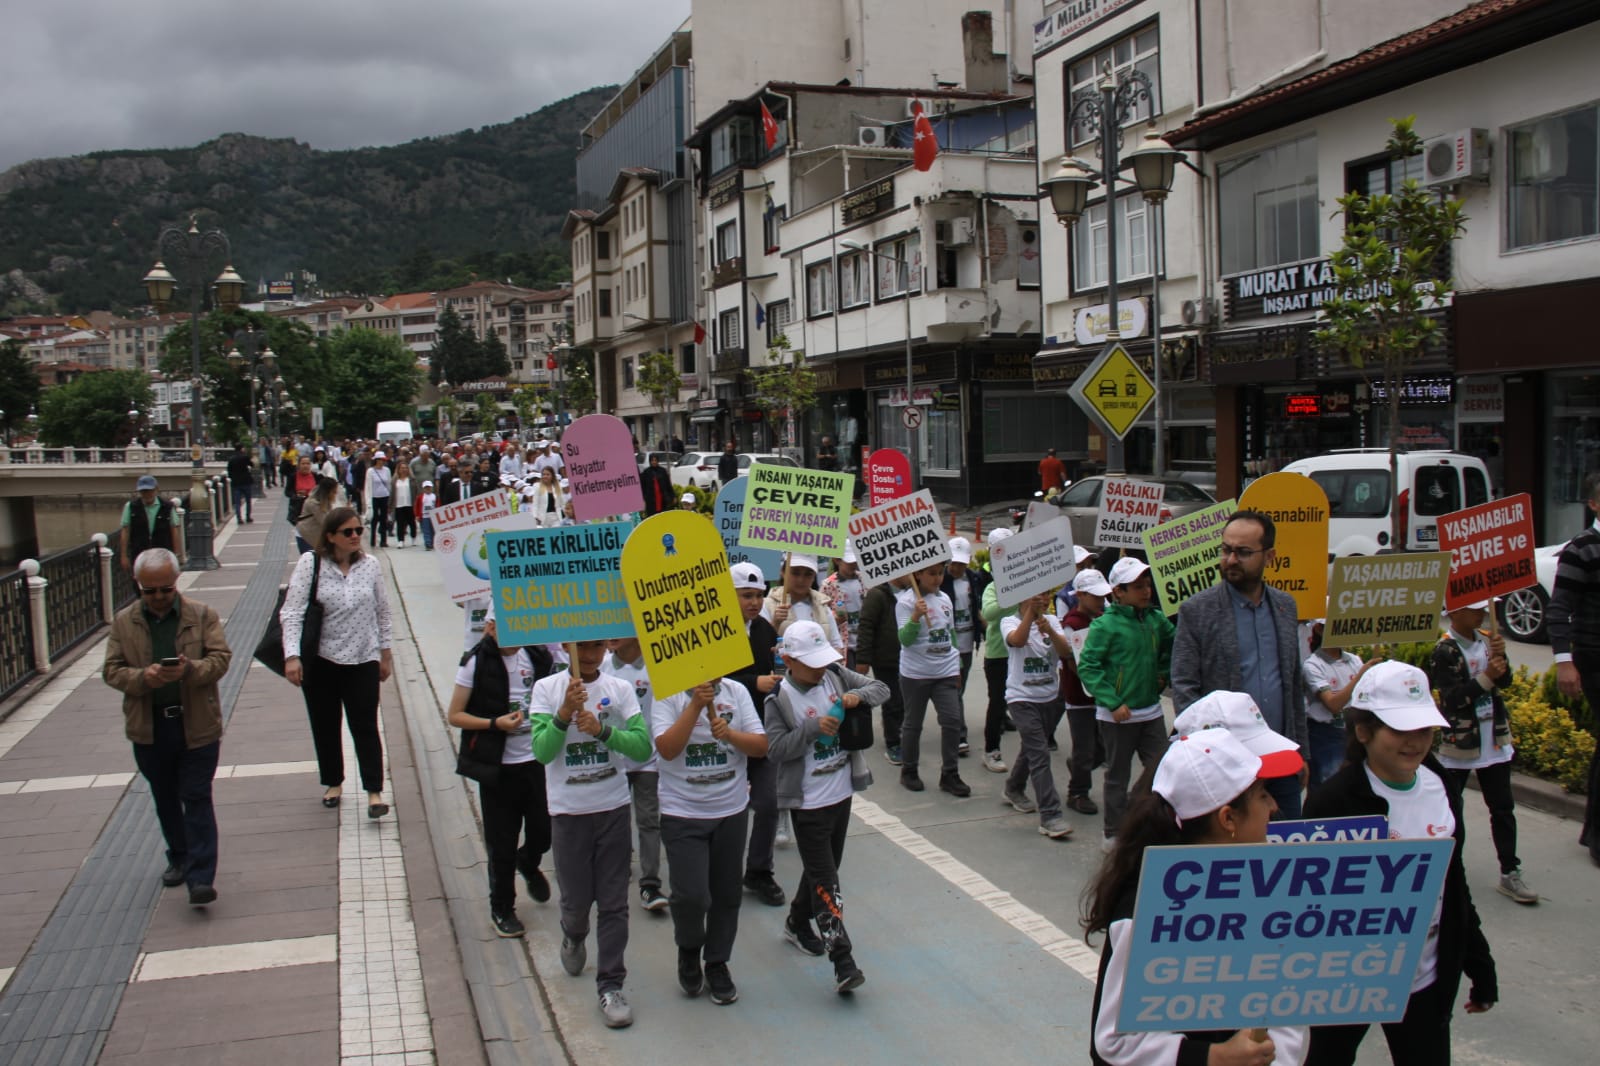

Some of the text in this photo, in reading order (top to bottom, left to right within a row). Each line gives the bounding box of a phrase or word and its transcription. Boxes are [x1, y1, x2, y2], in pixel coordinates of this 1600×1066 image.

[1239, 266, 1299, 298] MURAT
[1263, 293, 1309, 315] İNŞAAT
[566, 443, 579, 457] Su
[570, 460, 606, 477] Hayattır
[871, 464, 894, 473] Çevre
[872, 474, 895, 483] Dostu
[574, 474, 640, 495] Kirletmeyelim.
[795, 473, 843, 491] YAŞATAN
[873, 484, 895, 493] İnsan
[1106, 481, 1161, 500] SAĞLIKLI
[435, 495, 497, 525] LÜTFEN
[753, 487, 841, 513] ÇEVRE,
[1105, 497, 1158, 518] YAŞAM
[795, 512, 840, 530] YAŞATAN
[848, 496, 934, 536] UNUTMA,
[1149, 507, 1232, 547] HERKES SAĞLIKLI
[855, 513, 935, 551] ÇOCUKLARINDA
[1099, 534, 1121, 544] ÇEVRE
[497, 537, 546, 563] ÇEVRE
[860, 529, 940, 566] BURADA
[1450, 533, 1527, 574] ÇEVRE ve
[499, 556, 621, 579] HER ANIMIZI ETKİLEYE
[865, 545, 939, 580] YAŞAYACAK
[1157, 553, 1201, 578] YAŞAMAK
[633, 551, 727, 601] Unutmayalım!
[1450, 572, 1486, 598] MARKA
[502, 579, 590, 611] SAĞLIKLI
[1337, 587, 1437, 614] ÇEVRE ve
[642, 586, 721, 633] BAŞKA BİR
[505, 613, 548, 636] YAŞAM
[1331, 617, 1374, 636] MARKA
[650, 616, 737, 664] DÜNYA YOK.
[1150, 905, 1418, 944] HOR GÖREN
[1143, 942, 1408, 985] GELECEĞİ
[1135, 984, 1397, 1023] ZOR GÖRÜR.
